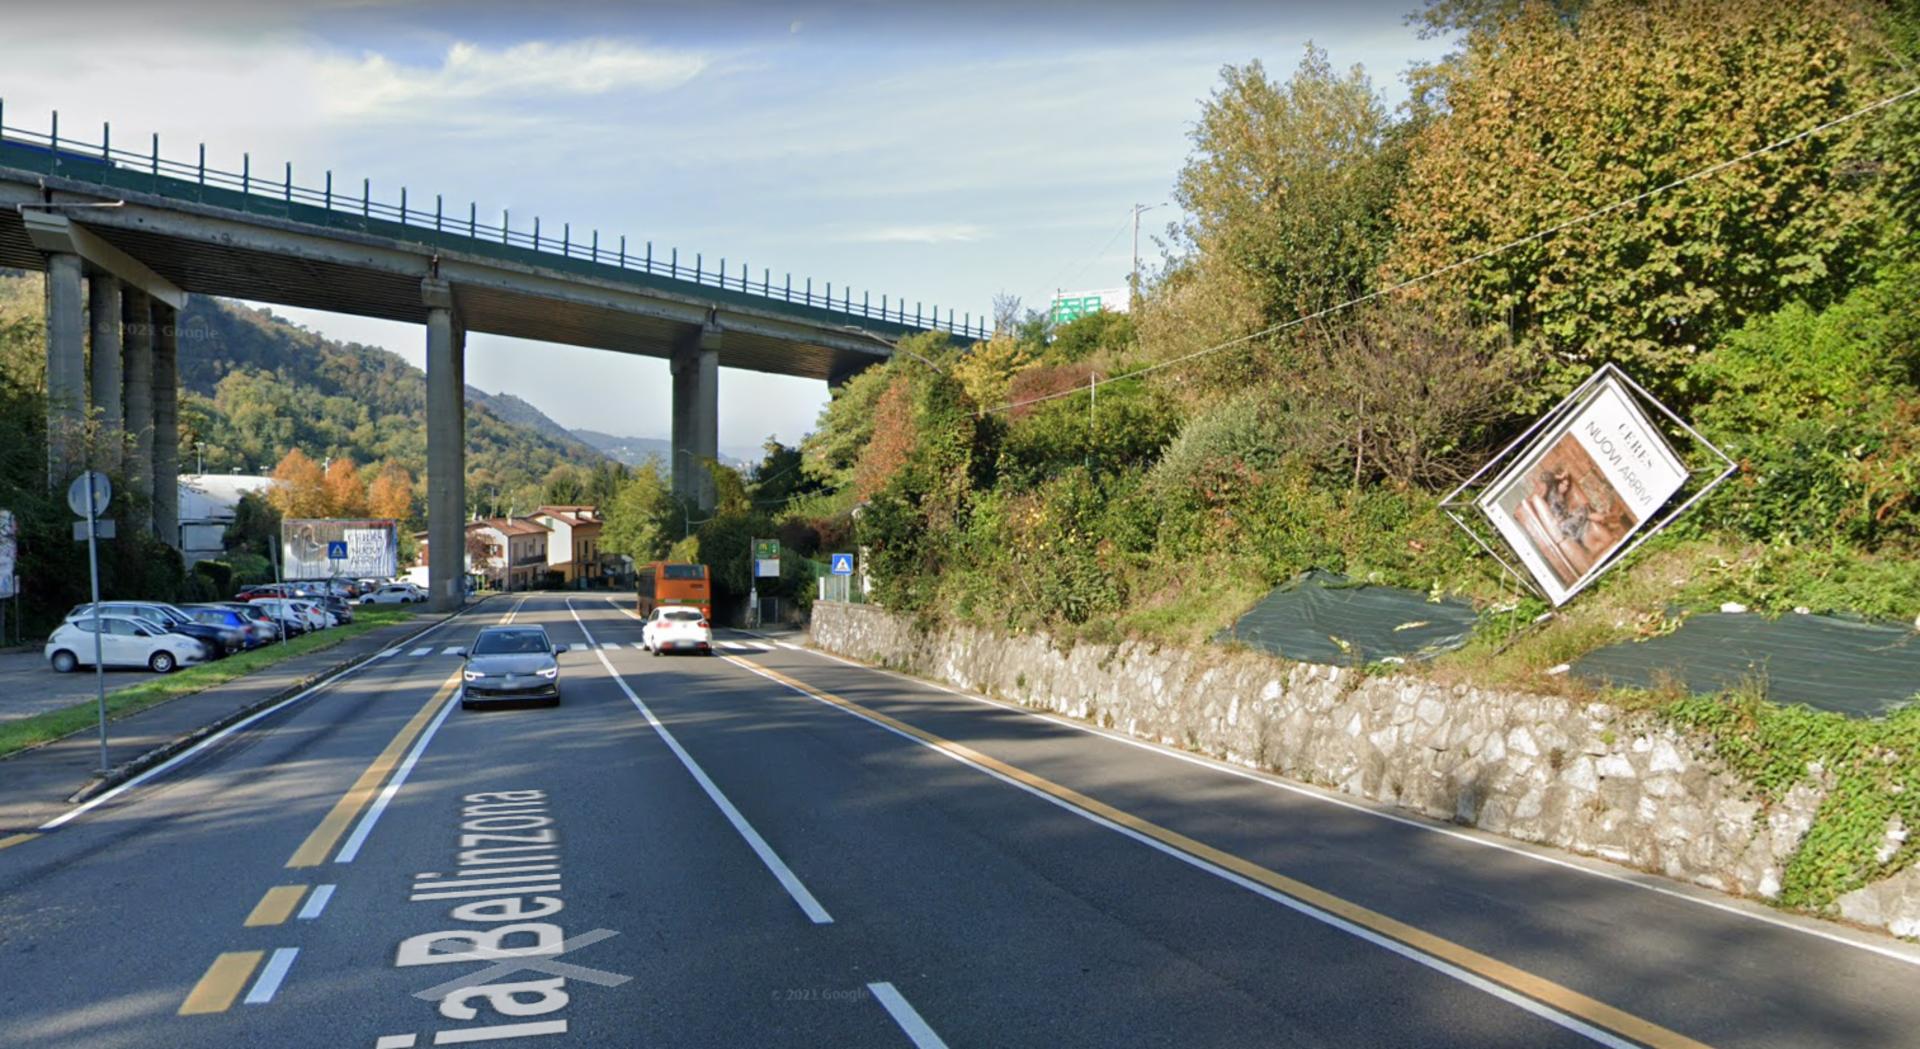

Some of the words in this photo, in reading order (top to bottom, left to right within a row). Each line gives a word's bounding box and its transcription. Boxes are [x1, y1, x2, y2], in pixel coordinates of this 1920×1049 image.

[1585, 421, 1622, 466] NUOVI
[1617, 465, 1653, 506] ARRIVI
[1619, 423, 1652, 468] CERES
